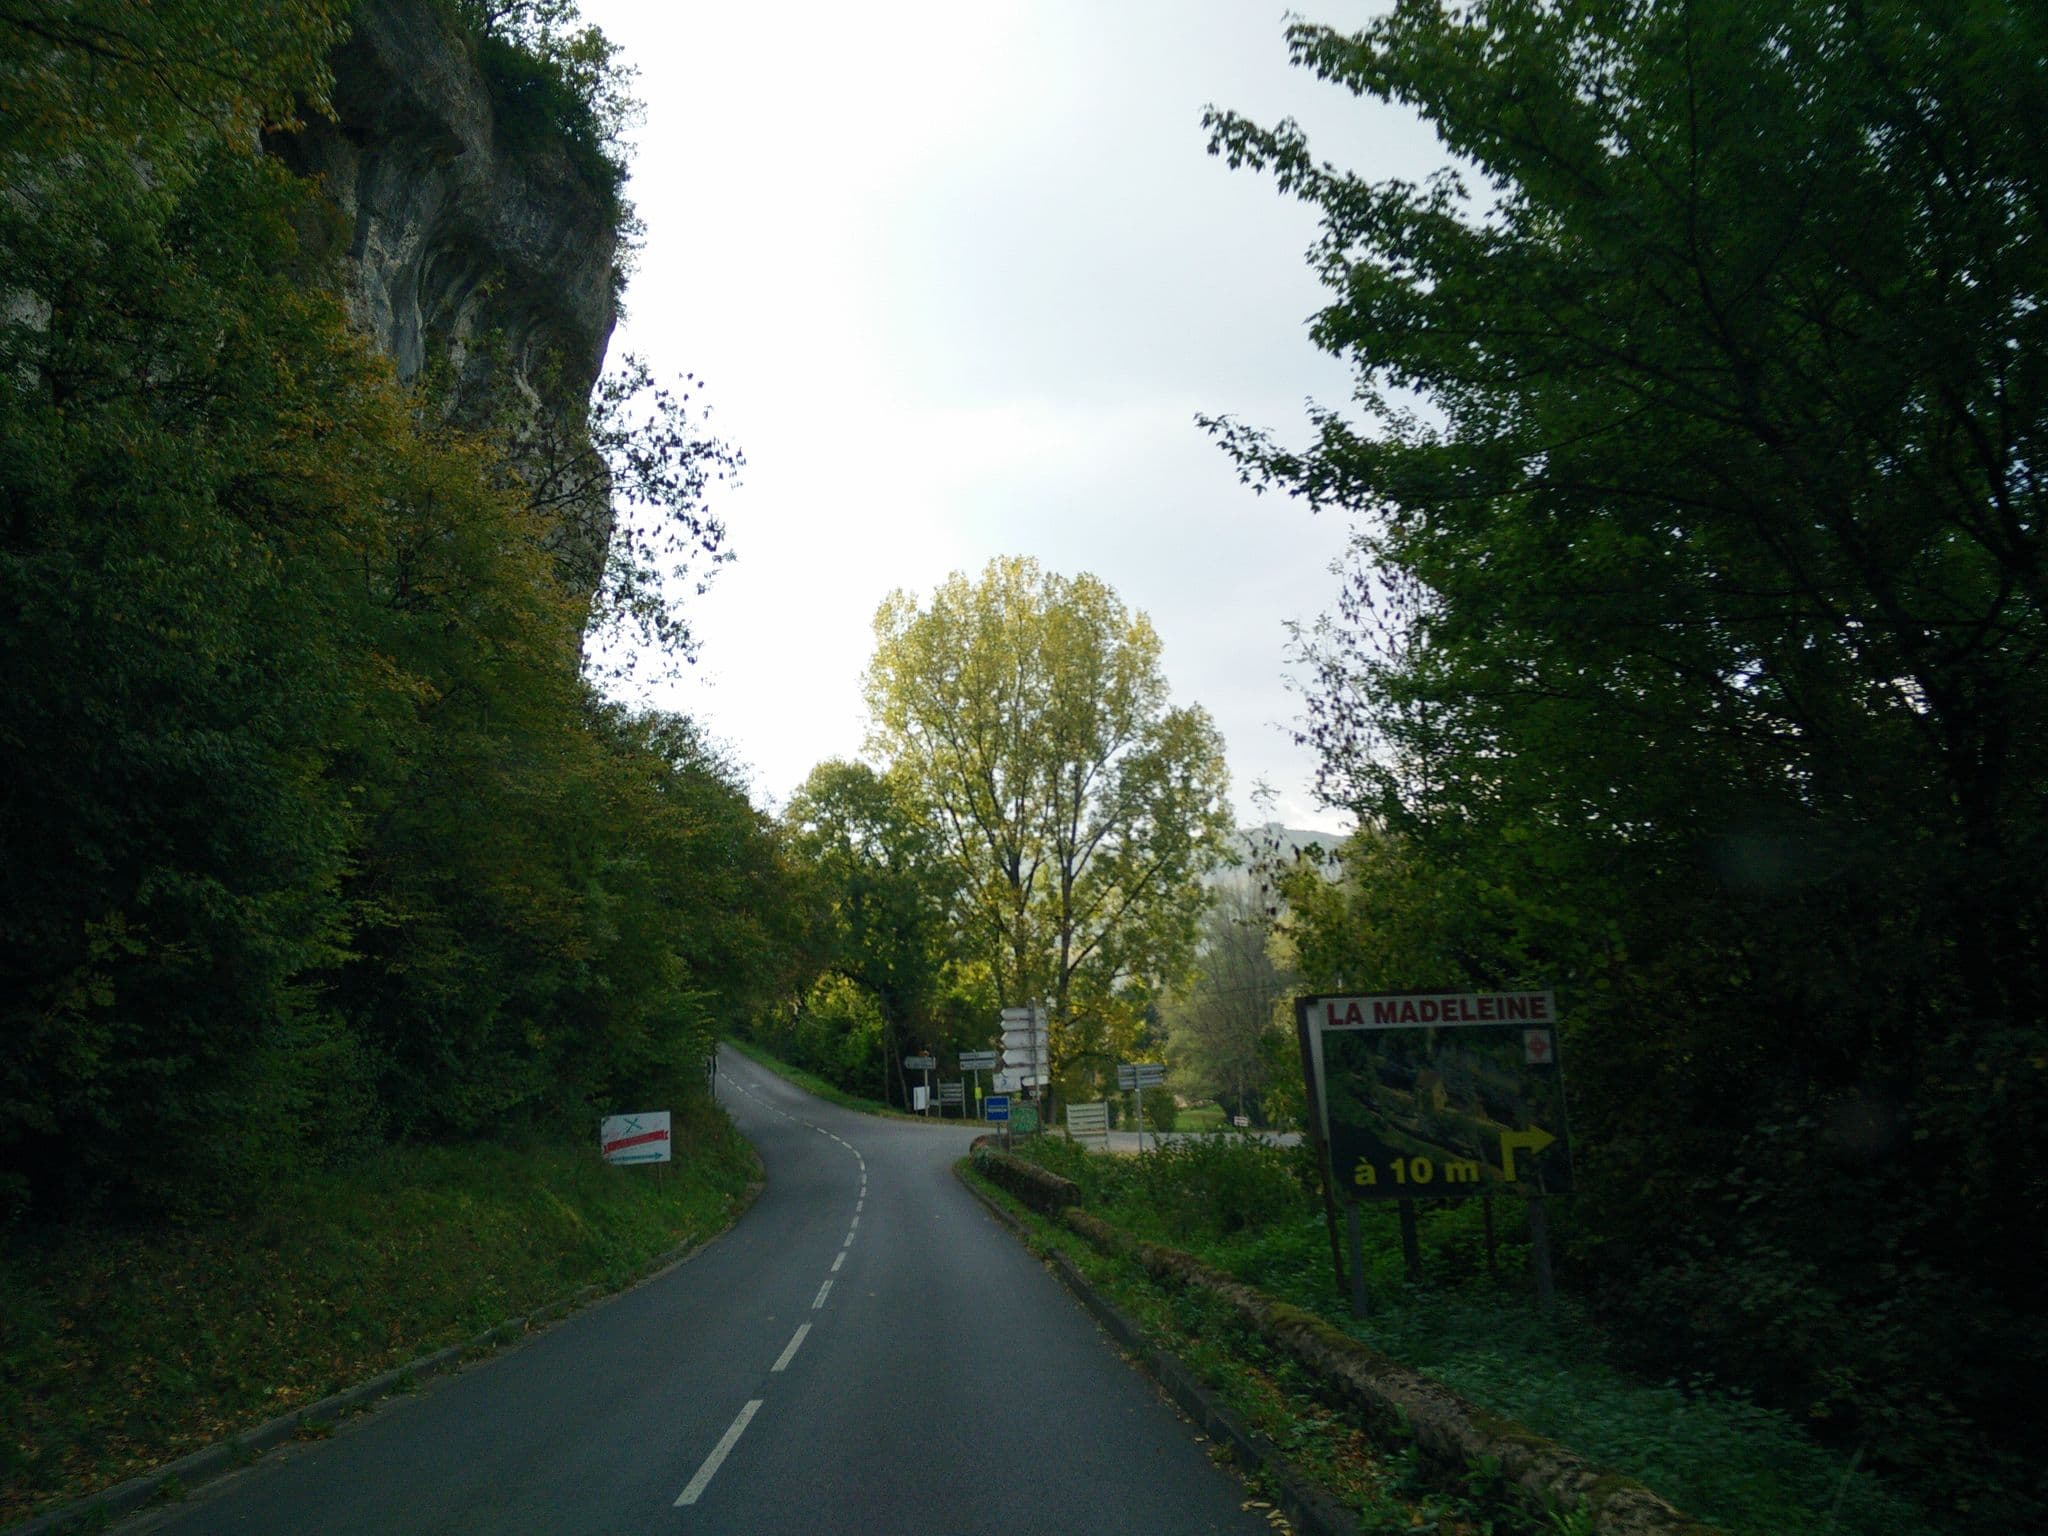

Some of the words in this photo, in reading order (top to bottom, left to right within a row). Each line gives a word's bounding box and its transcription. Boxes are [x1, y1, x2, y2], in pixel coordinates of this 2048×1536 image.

[1327, 1002, 1364, 1026] LA
[1373, 996, 1546, 1024] MADELEINE
[1354, 1156, 1377, 1185] à
[1390, 1156, 1433, 1184] 10
[1444, 1160, 1479, 1182] m
